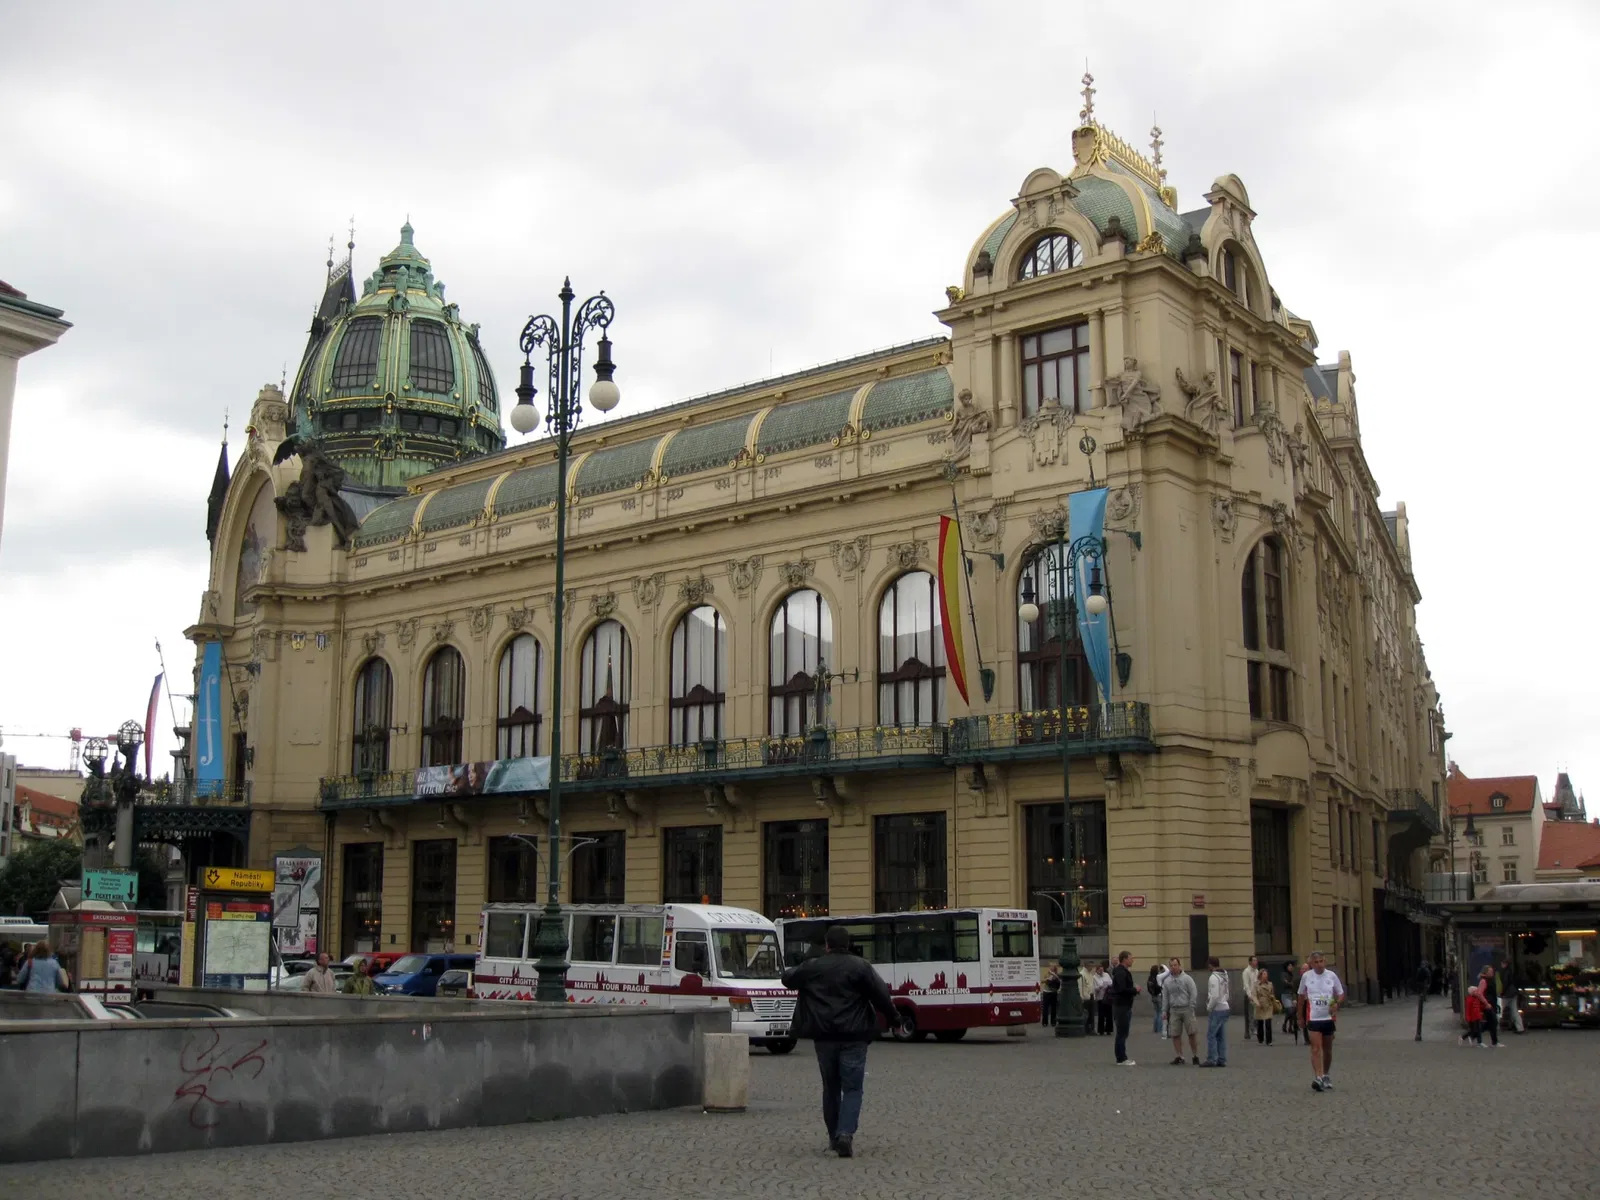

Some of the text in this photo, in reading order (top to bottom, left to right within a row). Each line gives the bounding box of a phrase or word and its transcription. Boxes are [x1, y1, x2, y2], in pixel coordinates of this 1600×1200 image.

[234, 872, 262, 880] Náměstí
[230, 879, 265, 889] Republiky
[574, 981, 650, 993] MARTIN TOUR PRAGUE
[925, 987, 970, 996] SIGHTSEEING
